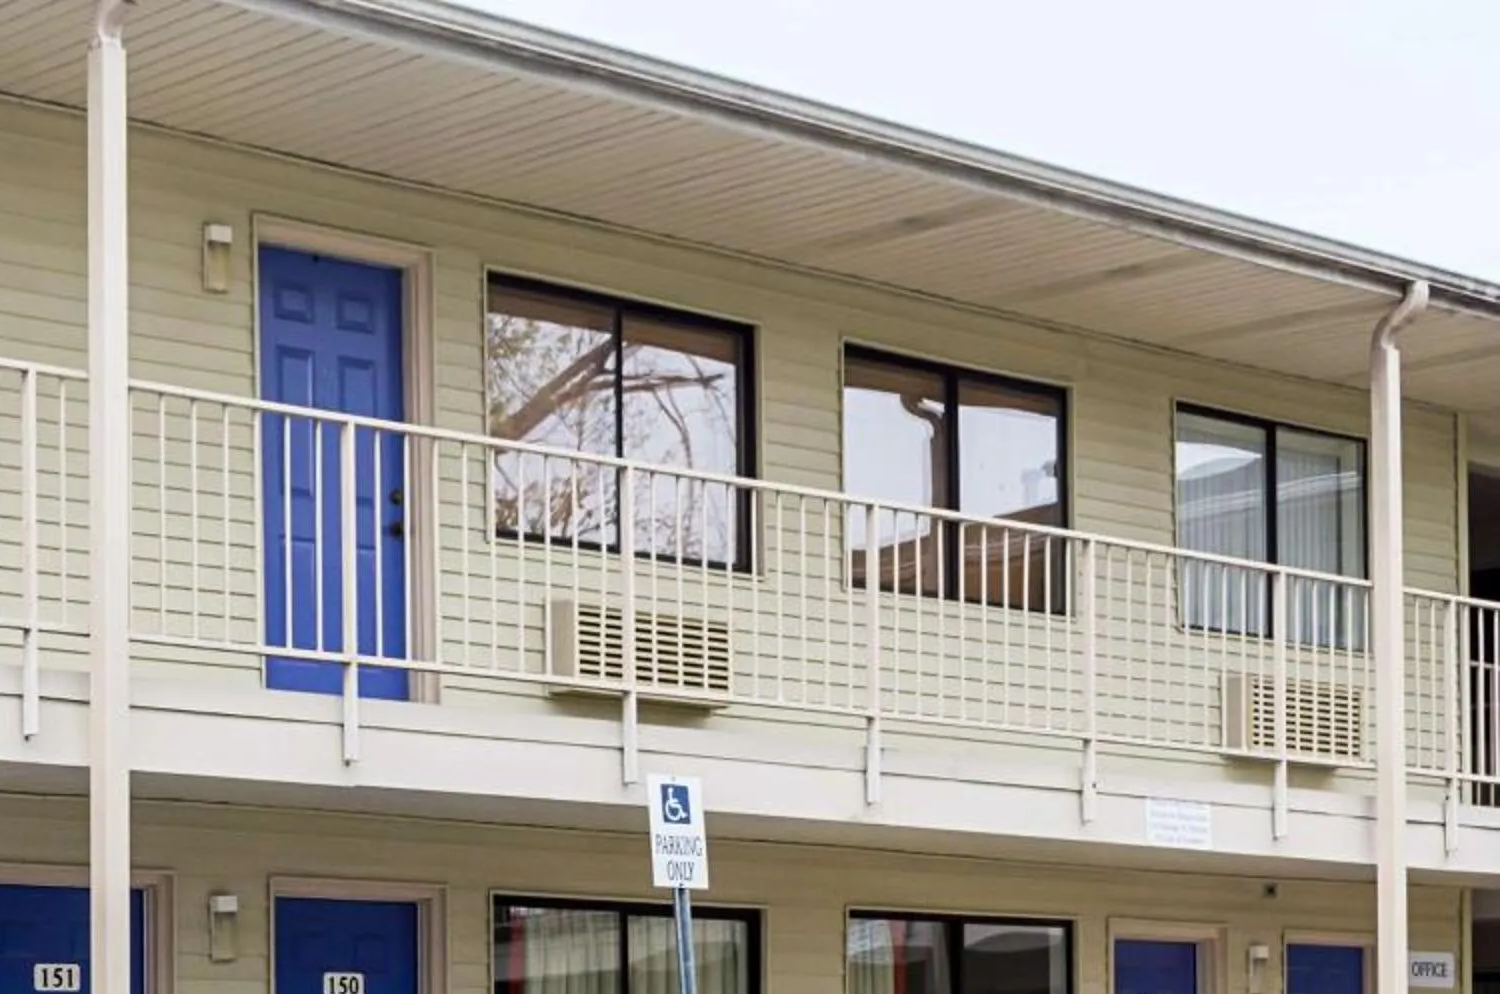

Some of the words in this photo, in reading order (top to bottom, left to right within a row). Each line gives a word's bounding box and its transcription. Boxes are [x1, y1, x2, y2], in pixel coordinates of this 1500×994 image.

[655, 833, 703, 857] PARKING
[666, 860, 695, 881] ONLY
[41, 968, 74, 988] 151
[1411, 961, 1448, 978] OFFICE
